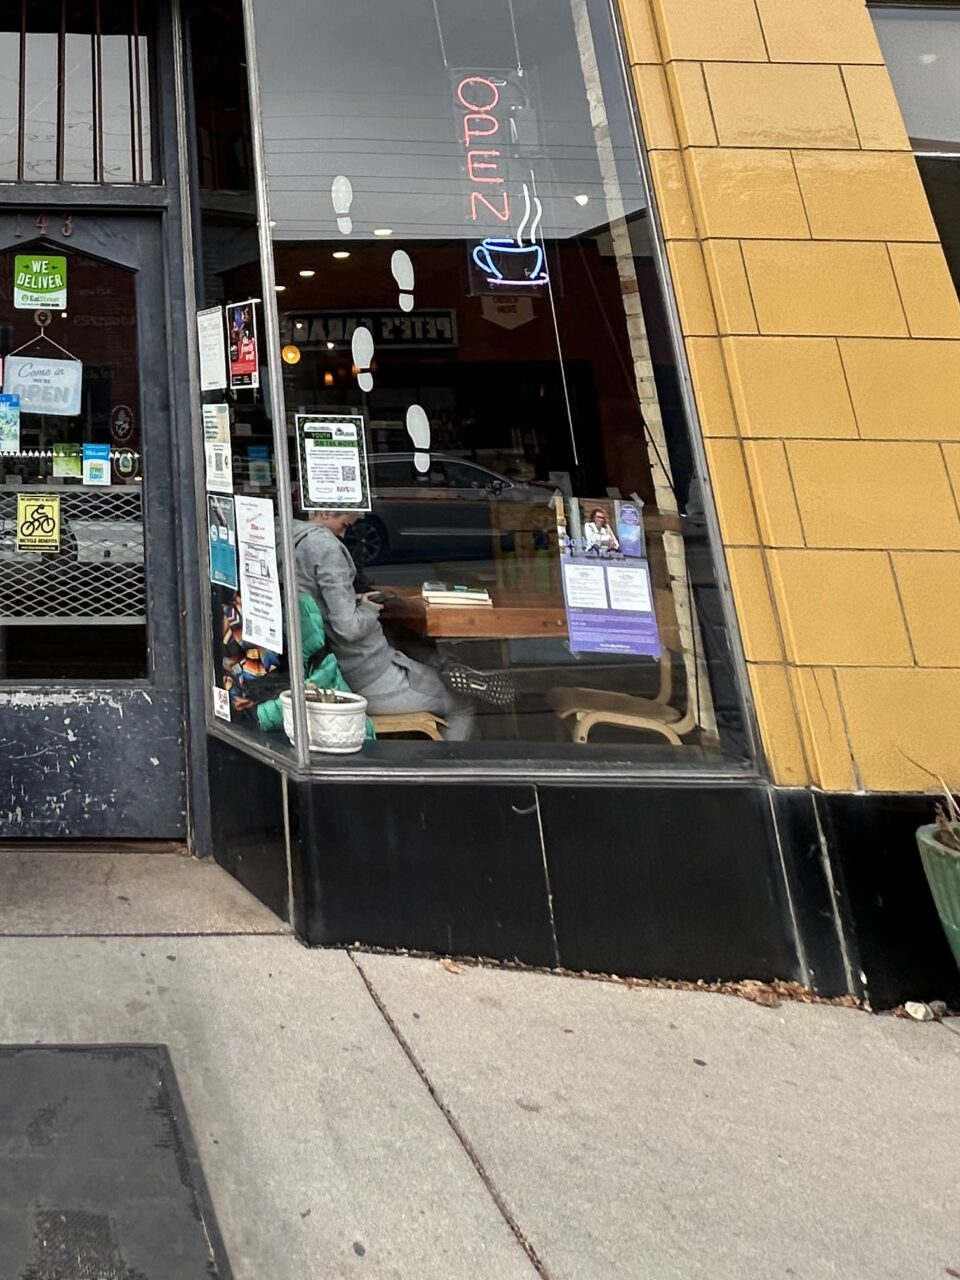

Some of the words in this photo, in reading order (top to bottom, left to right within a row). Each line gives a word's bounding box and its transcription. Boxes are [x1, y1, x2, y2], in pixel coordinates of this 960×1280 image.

[458, 77, 509, 221] OPEN
[31, 260, 50, 273] WE
[16, 273, 63, 289] DELIVER
[18, 362, 51, 378] Come
[54, 367, 65, 376] in
[12, 383, 71, 404] OPEN
